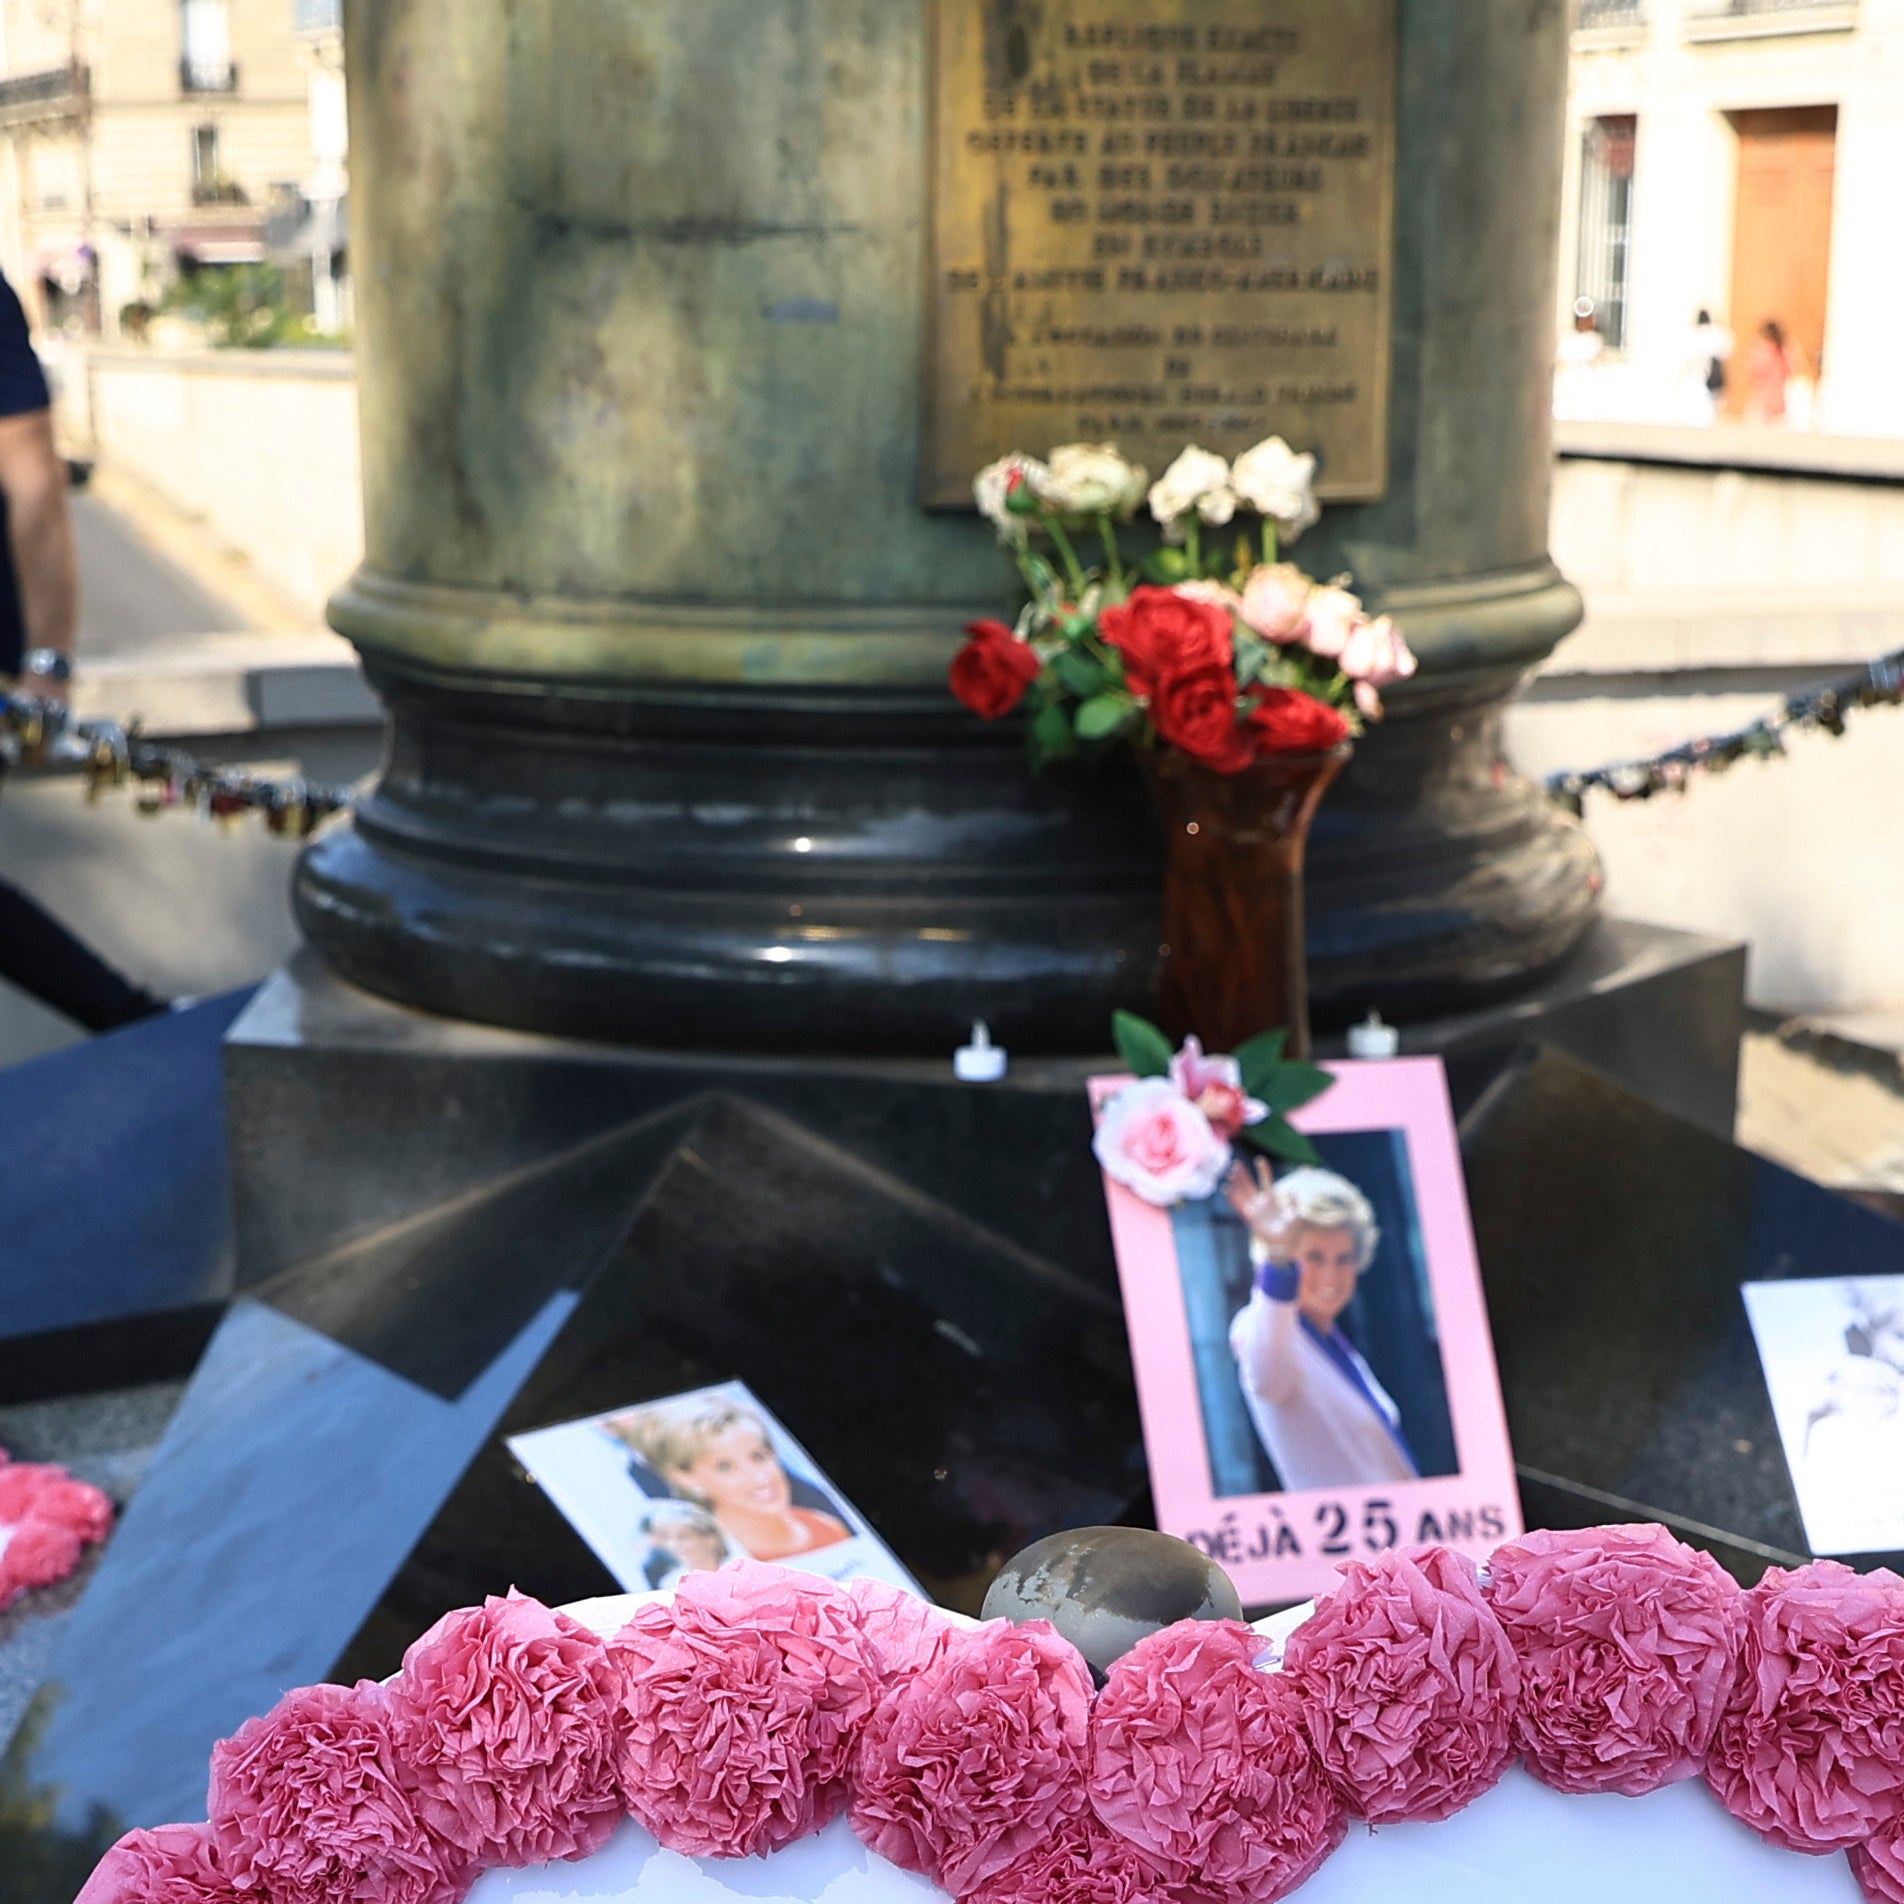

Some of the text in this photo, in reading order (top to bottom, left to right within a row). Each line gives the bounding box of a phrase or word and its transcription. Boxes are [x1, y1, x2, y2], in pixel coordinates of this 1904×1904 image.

[1187, 1500, 1507, 1564] DÉJÀ 25 ANS
